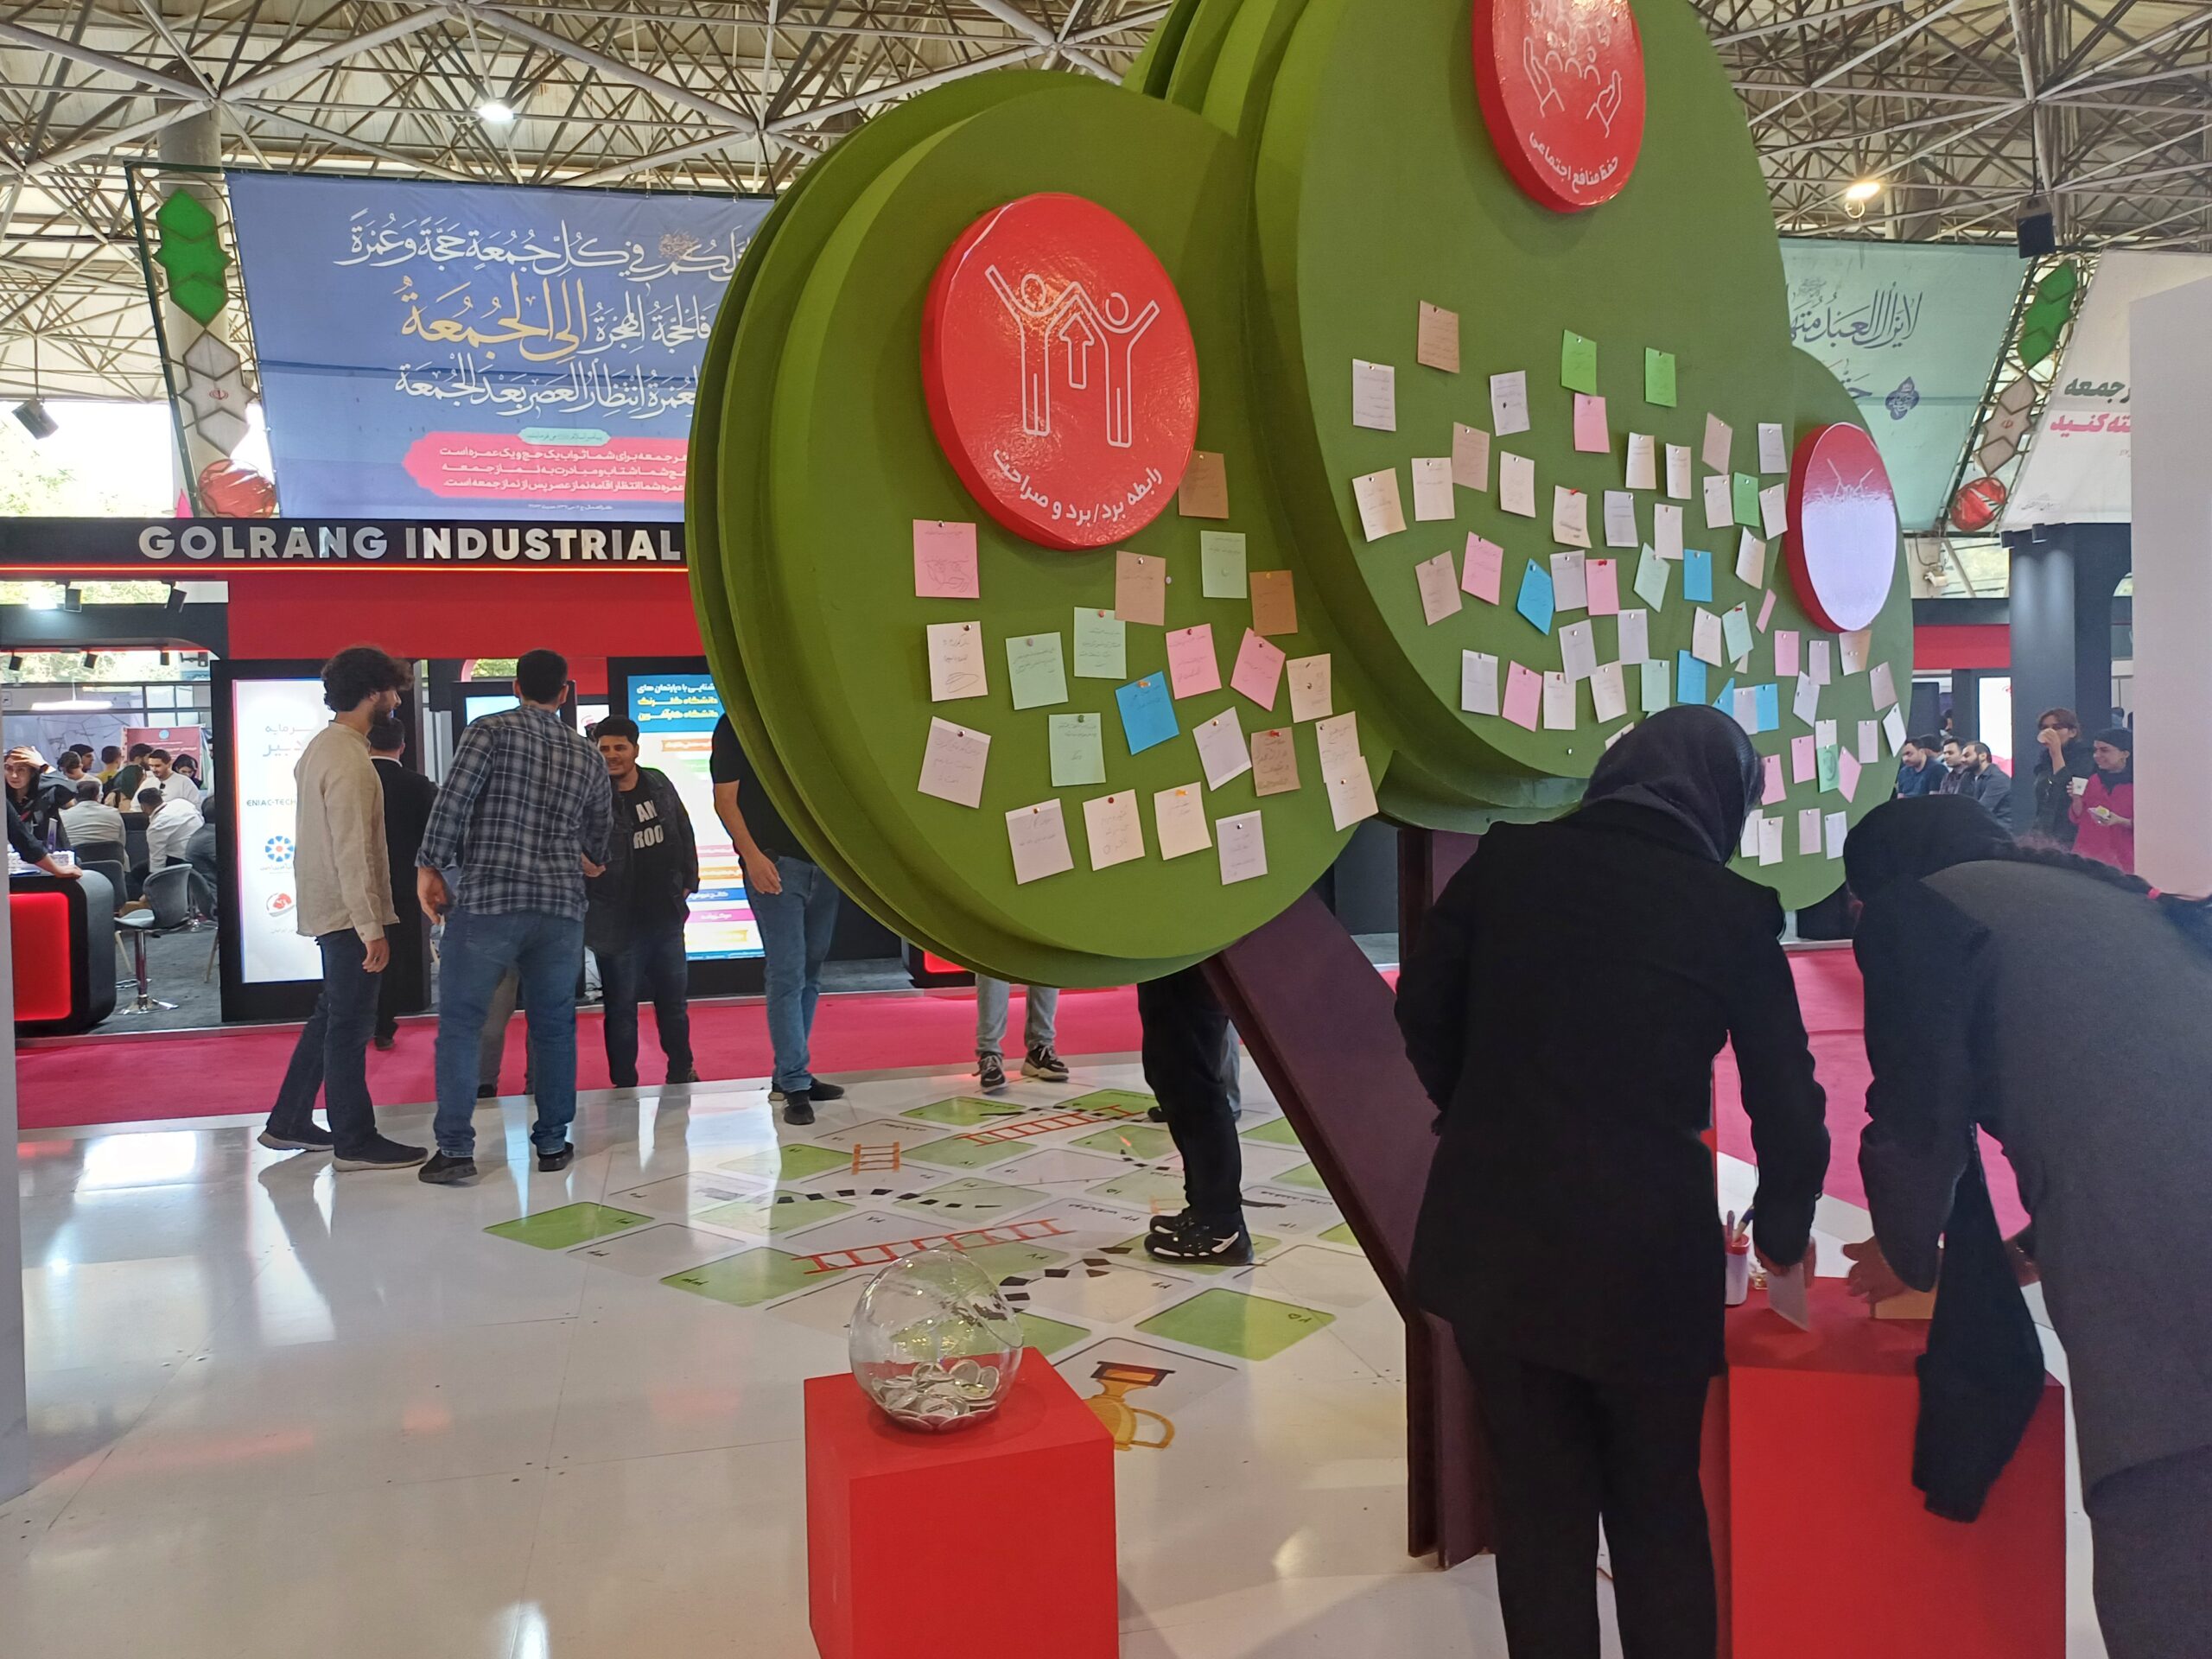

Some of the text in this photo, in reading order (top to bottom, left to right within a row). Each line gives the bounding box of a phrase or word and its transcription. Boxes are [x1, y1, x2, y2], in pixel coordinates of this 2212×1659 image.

[1599, 156, 1618, 180] حفظ
[1572, 168, 1599, 194] منافع
[2064, 378, 2125, 404] جمعه
[440, 446, 469, 456] است
[587, 450, 615, 461] شما
[616, 451, 638, 461] برای
[442, 463, 494, 474] جمعه
[639, 467, 669, 476] شما
[994, 449, 1049, 507] صراحت
[1127, 467, 1162, 505] رابطه
[1052, 501, 1062, 519] و
[139, 526, 681, 561] GOLRANG INDUSTRIAL
